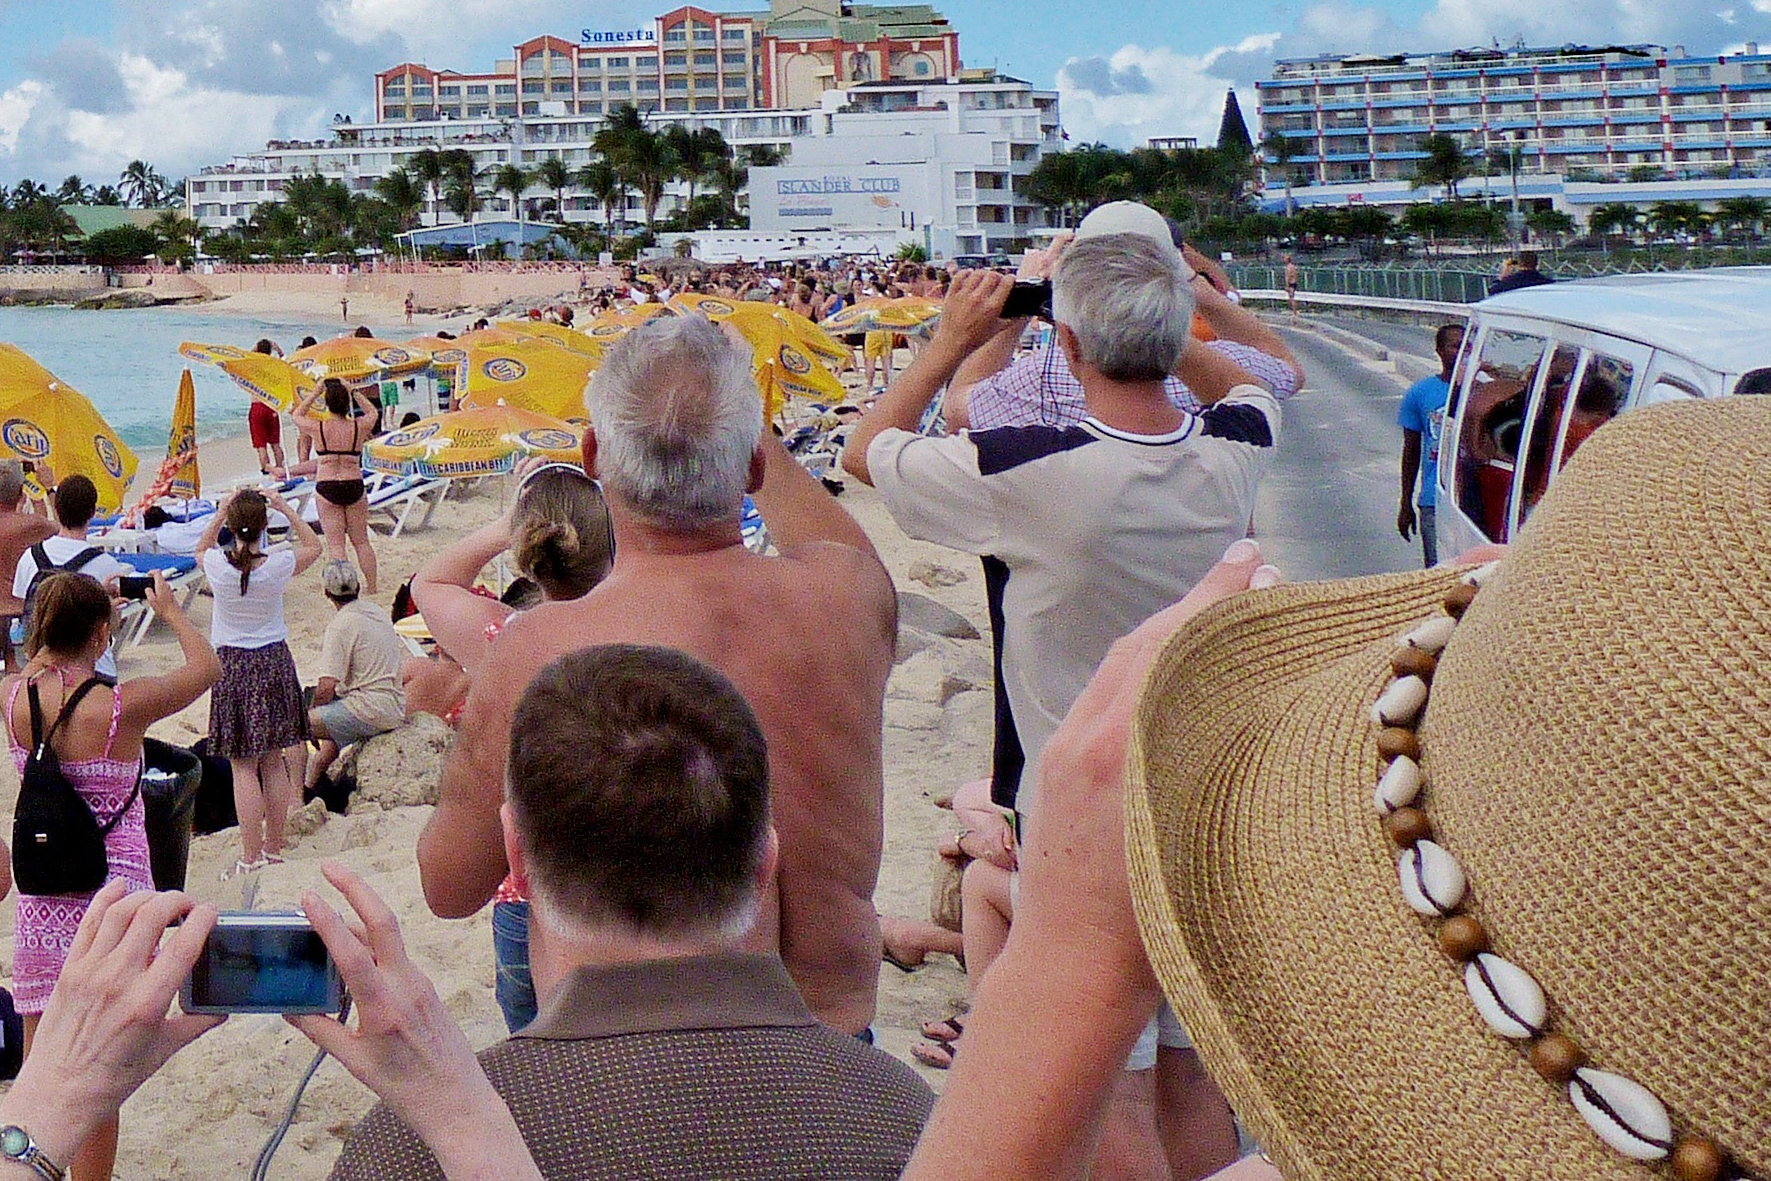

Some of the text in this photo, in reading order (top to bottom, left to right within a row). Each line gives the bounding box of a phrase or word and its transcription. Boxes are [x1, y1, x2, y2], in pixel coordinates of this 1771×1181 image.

[581, 28, 655, 43] Sonesta
[777, 178, 900, 194] ISLANDER CLUB
[438, 459, 487, 473] CARIBBEAN
